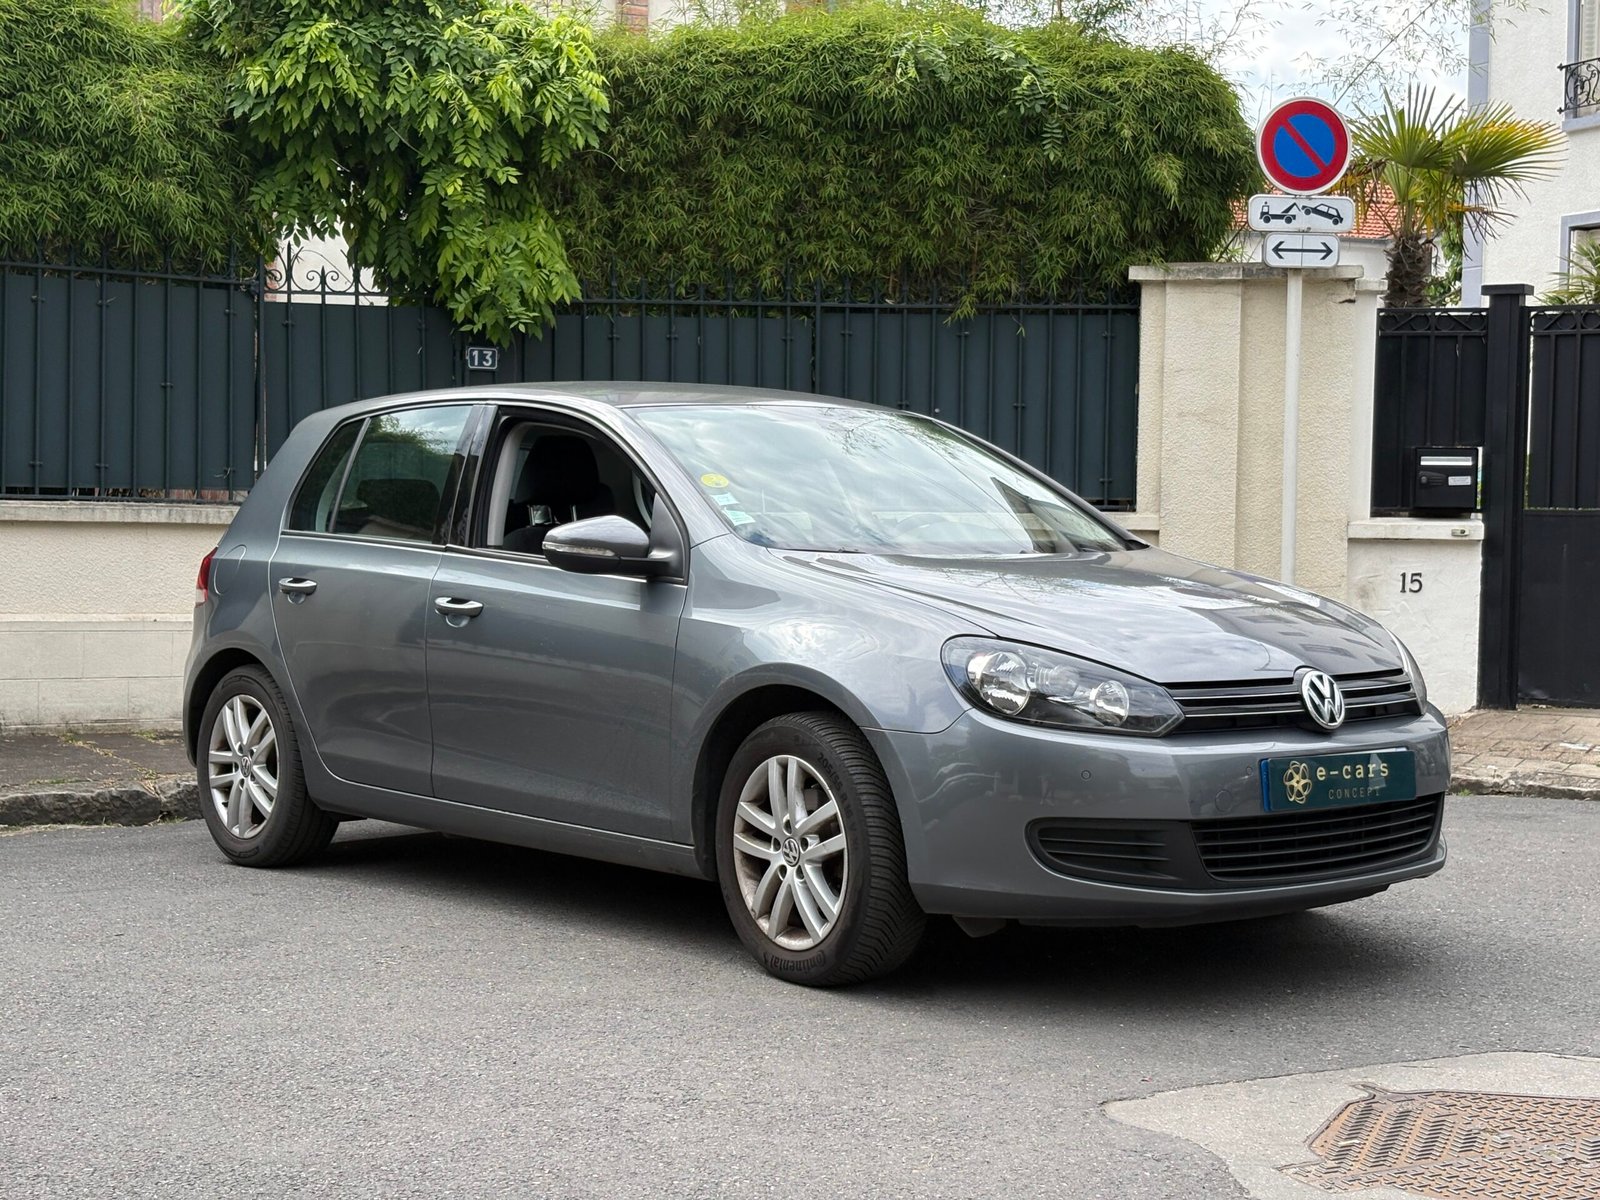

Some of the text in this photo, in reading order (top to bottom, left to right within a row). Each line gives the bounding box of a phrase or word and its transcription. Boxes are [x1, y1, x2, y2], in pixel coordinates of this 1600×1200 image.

[472, 350, 492, 366] 13
[1400, 572, 1423, 593] 15
[1316, 762, 1389, 781] e-cars
[771, 949, 826, 974] Continental
